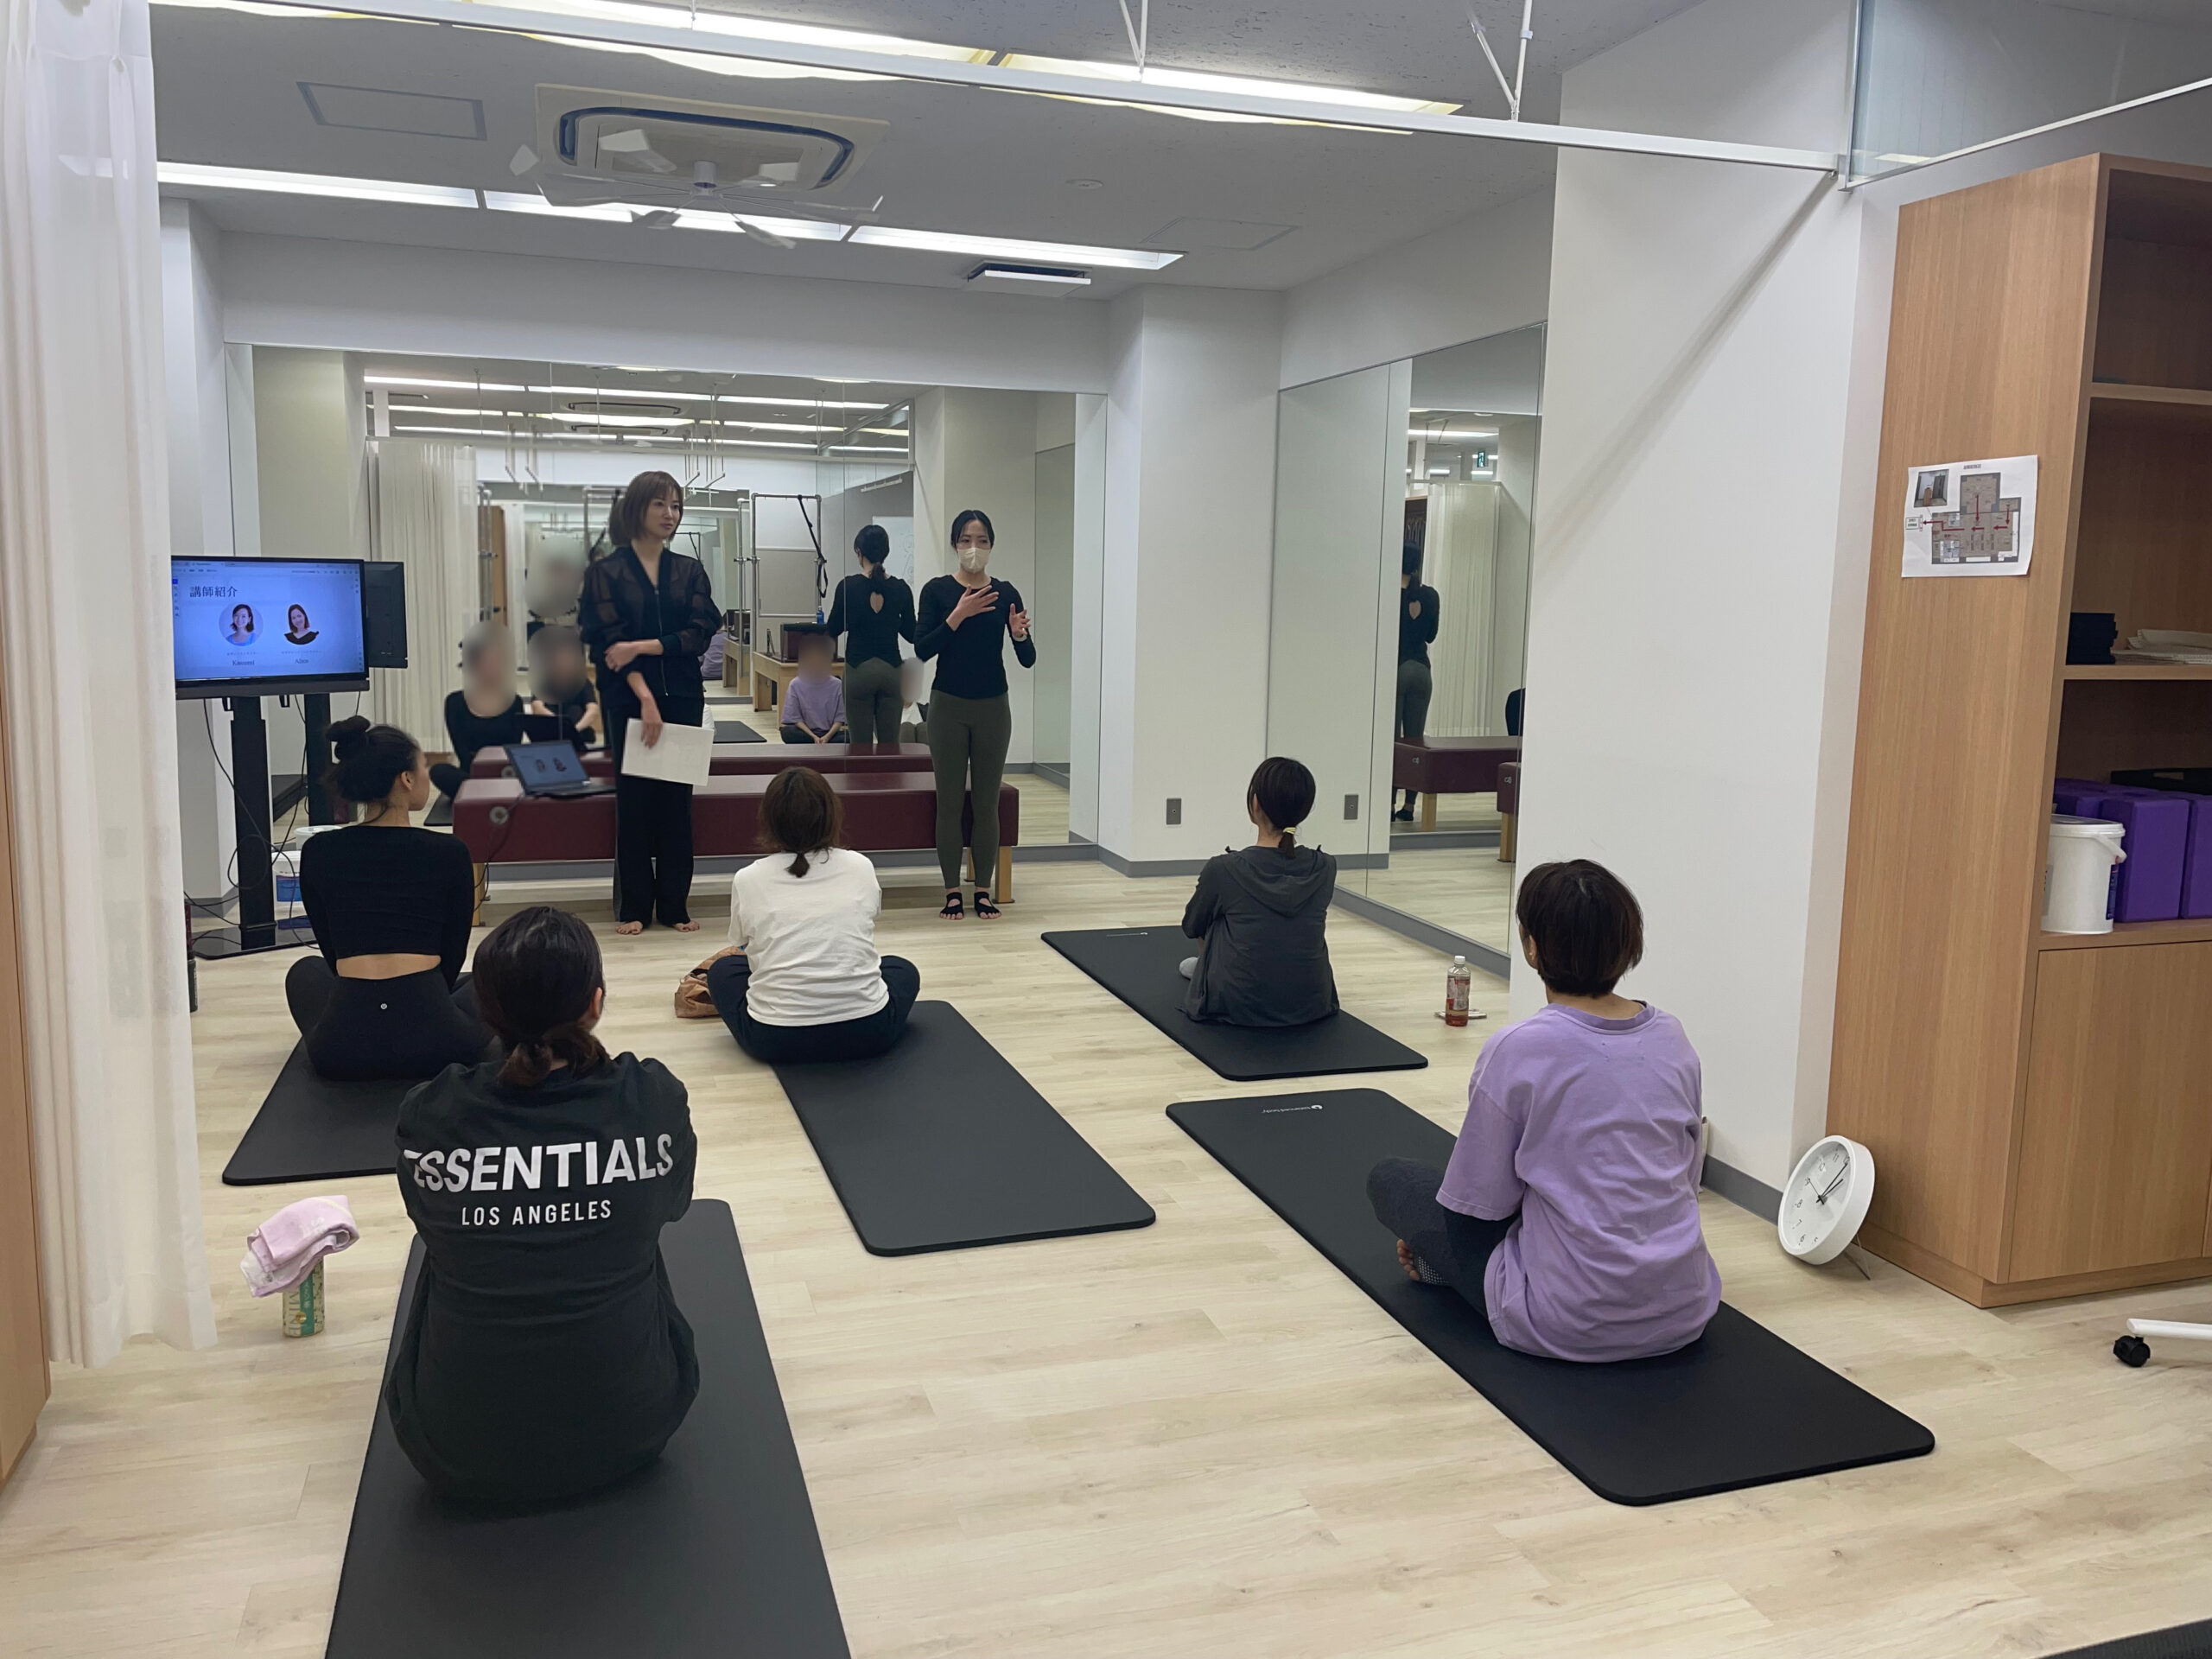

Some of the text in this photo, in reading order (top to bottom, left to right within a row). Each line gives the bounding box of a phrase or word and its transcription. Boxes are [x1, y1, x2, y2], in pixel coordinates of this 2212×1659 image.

[189, 585, 238, 598] 講師紹介
[403, 1134, 673, 1192] ESSENTIALS
[461, 1199, 612, 1226] LOS ANGELES
